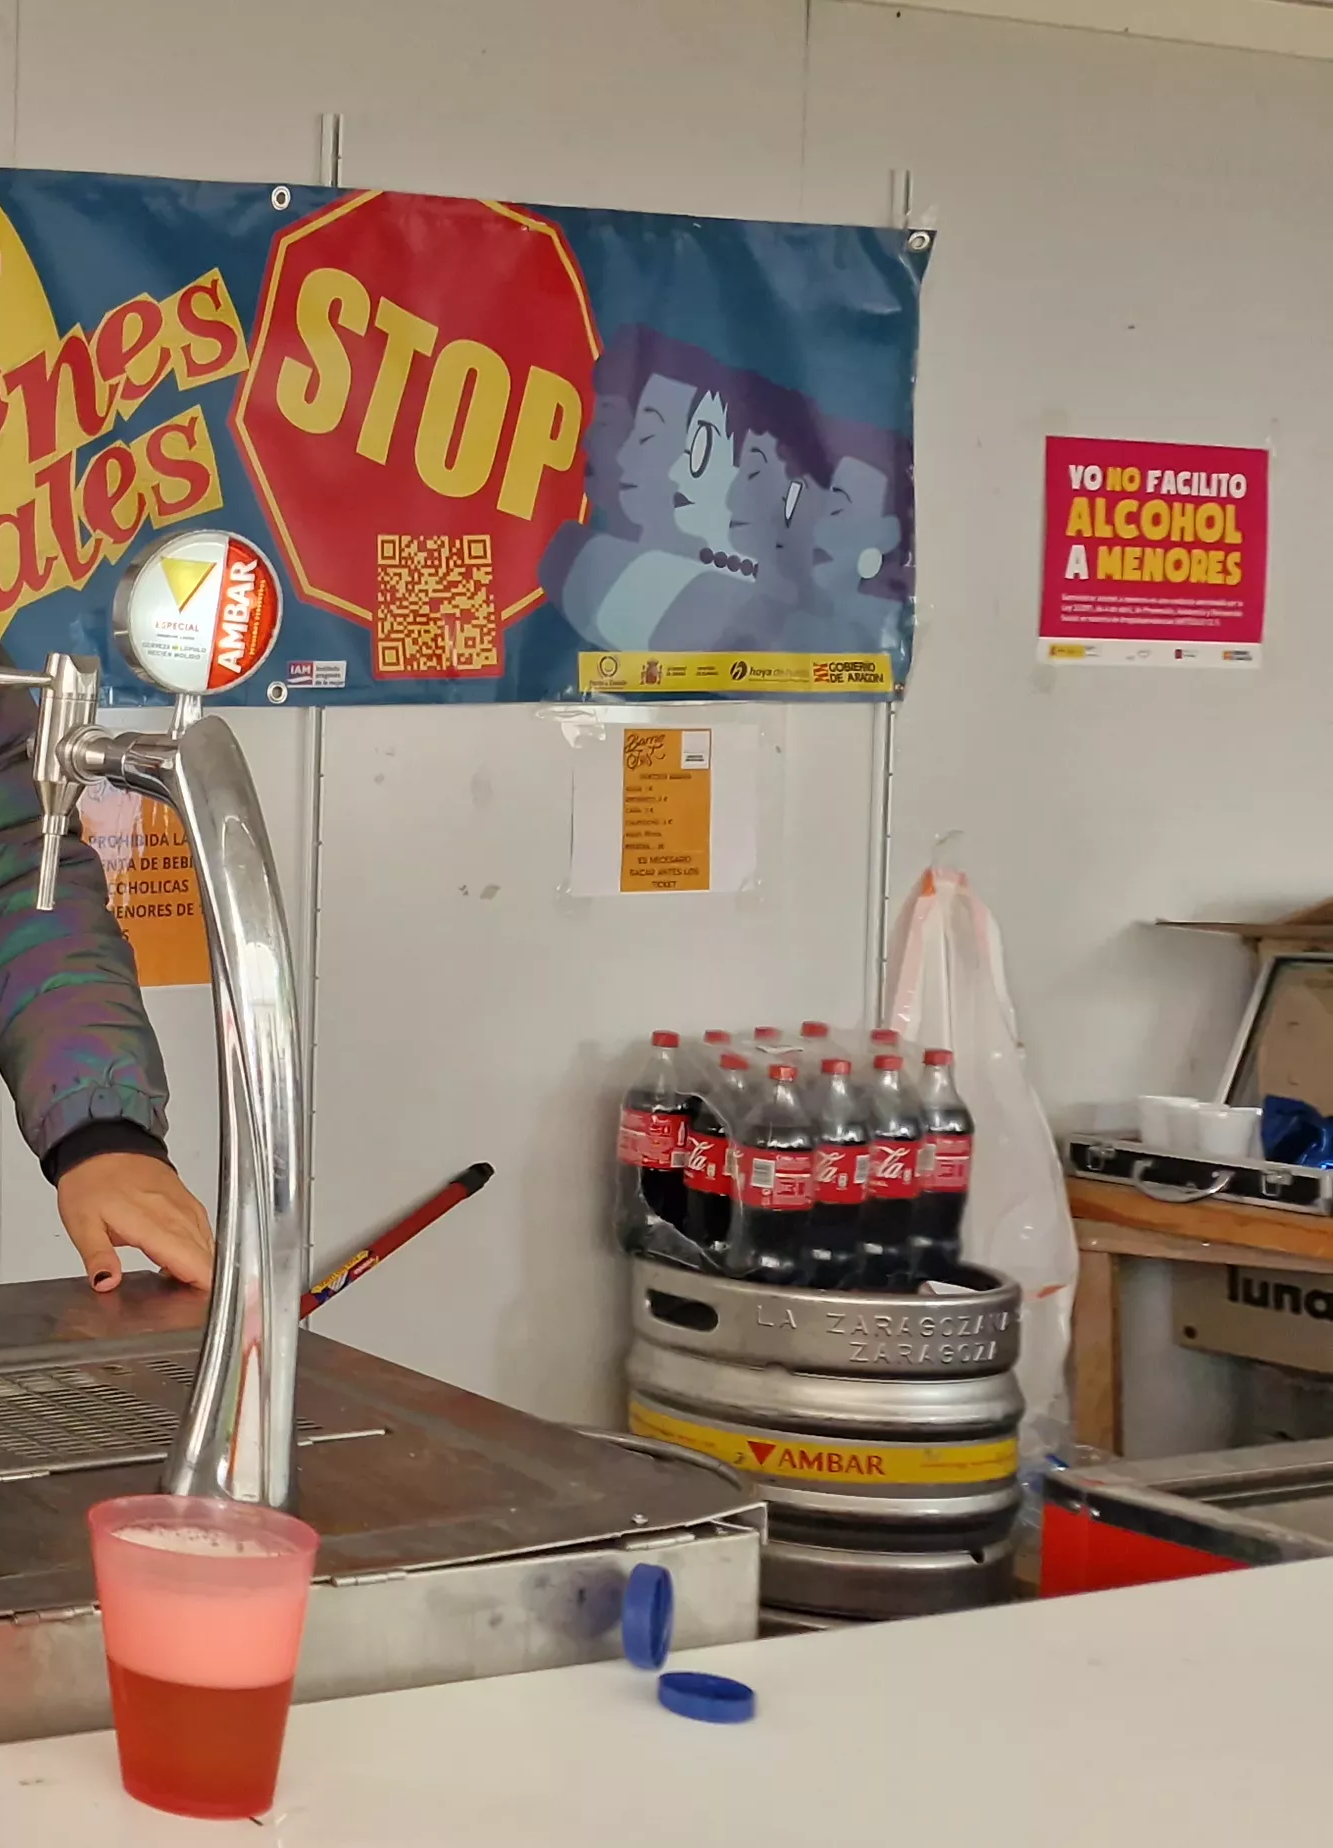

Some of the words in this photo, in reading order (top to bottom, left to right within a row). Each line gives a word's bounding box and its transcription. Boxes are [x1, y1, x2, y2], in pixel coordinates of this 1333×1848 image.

[276, 267, 582, 521] STOP
[1068, 464, 1102, 492] YO
[1106, 466, 1141, 492] NO
[1145, 469, 1247, 498] FACILITO
[1064, 496, 1243, 544] ALCOHOL
[1064, 544, 1089, 580] A
[1096, 545, 1243, 586] MENORES
[217, 559, 258, 674] AMBAR
[290, 664, 312, 675] IAM
[88, 833, 170, 849] PROHIBIDA
[140, 856, 159, 871] DE
[162, 855, 194, 870] BEBI
[106, 879, 190, 895] COHOLICAS
[114, 903, 173, 919] ENORES
[176, 903, 194, 917] DE
[757, 1305, 798, 1329] LA
[778, 1448, 886, 1477] AMBAR
